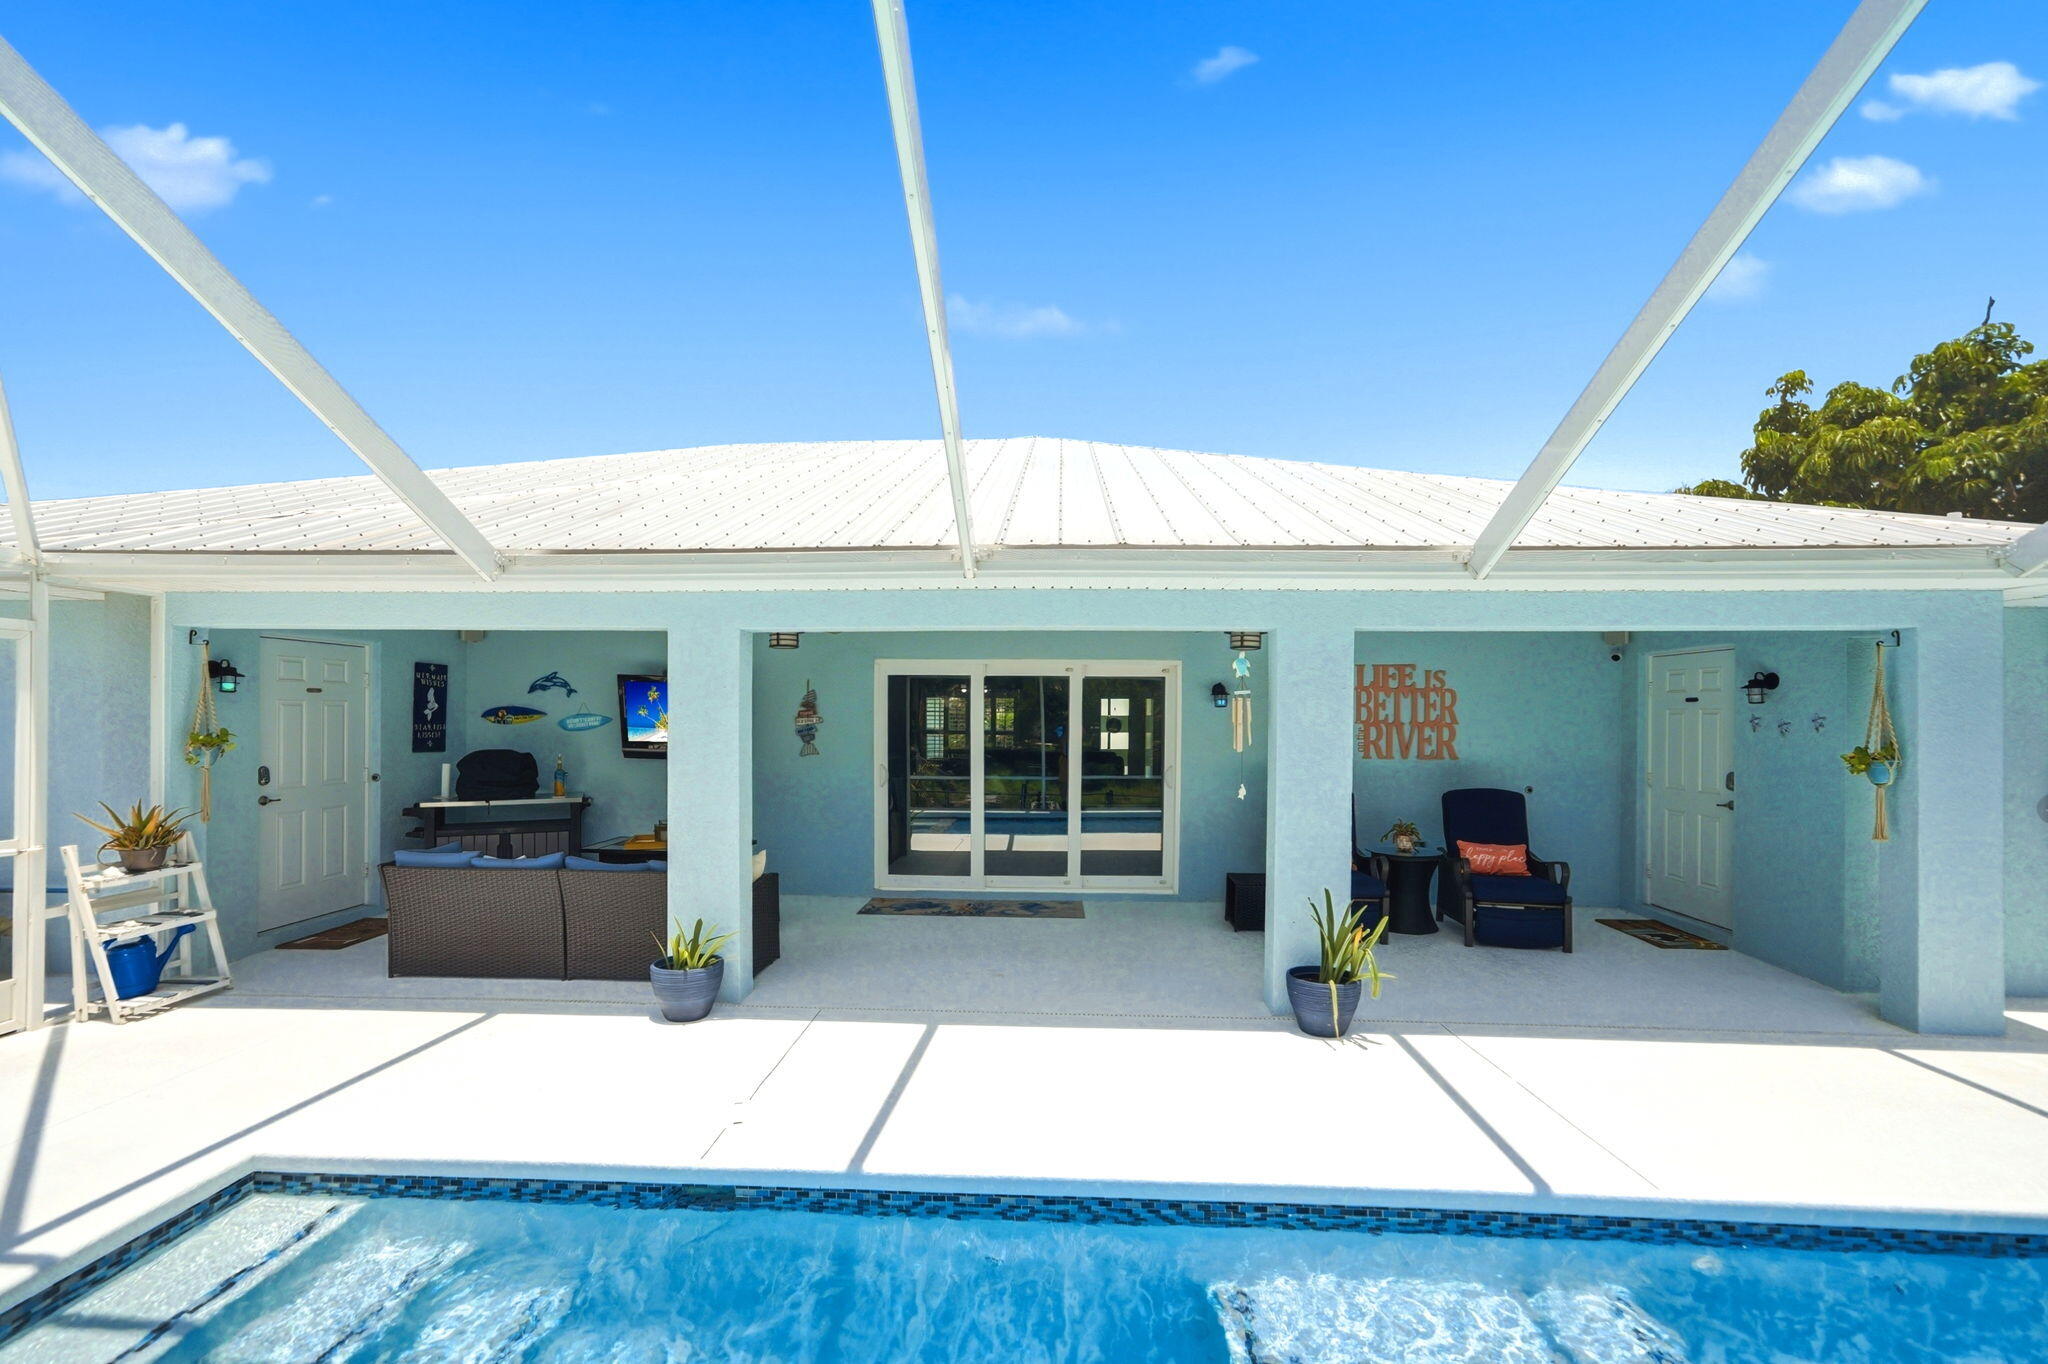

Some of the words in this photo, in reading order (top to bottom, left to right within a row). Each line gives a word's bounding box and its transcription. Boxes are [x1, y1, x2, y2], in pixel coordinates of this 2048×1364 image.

[1355, 664, 1417, 690] LIFE
[1424, 669, 1447, 689] IS
[1354, 687, 1459, 725] BETTER
[1362, 722, 1460, 760] RIVER
